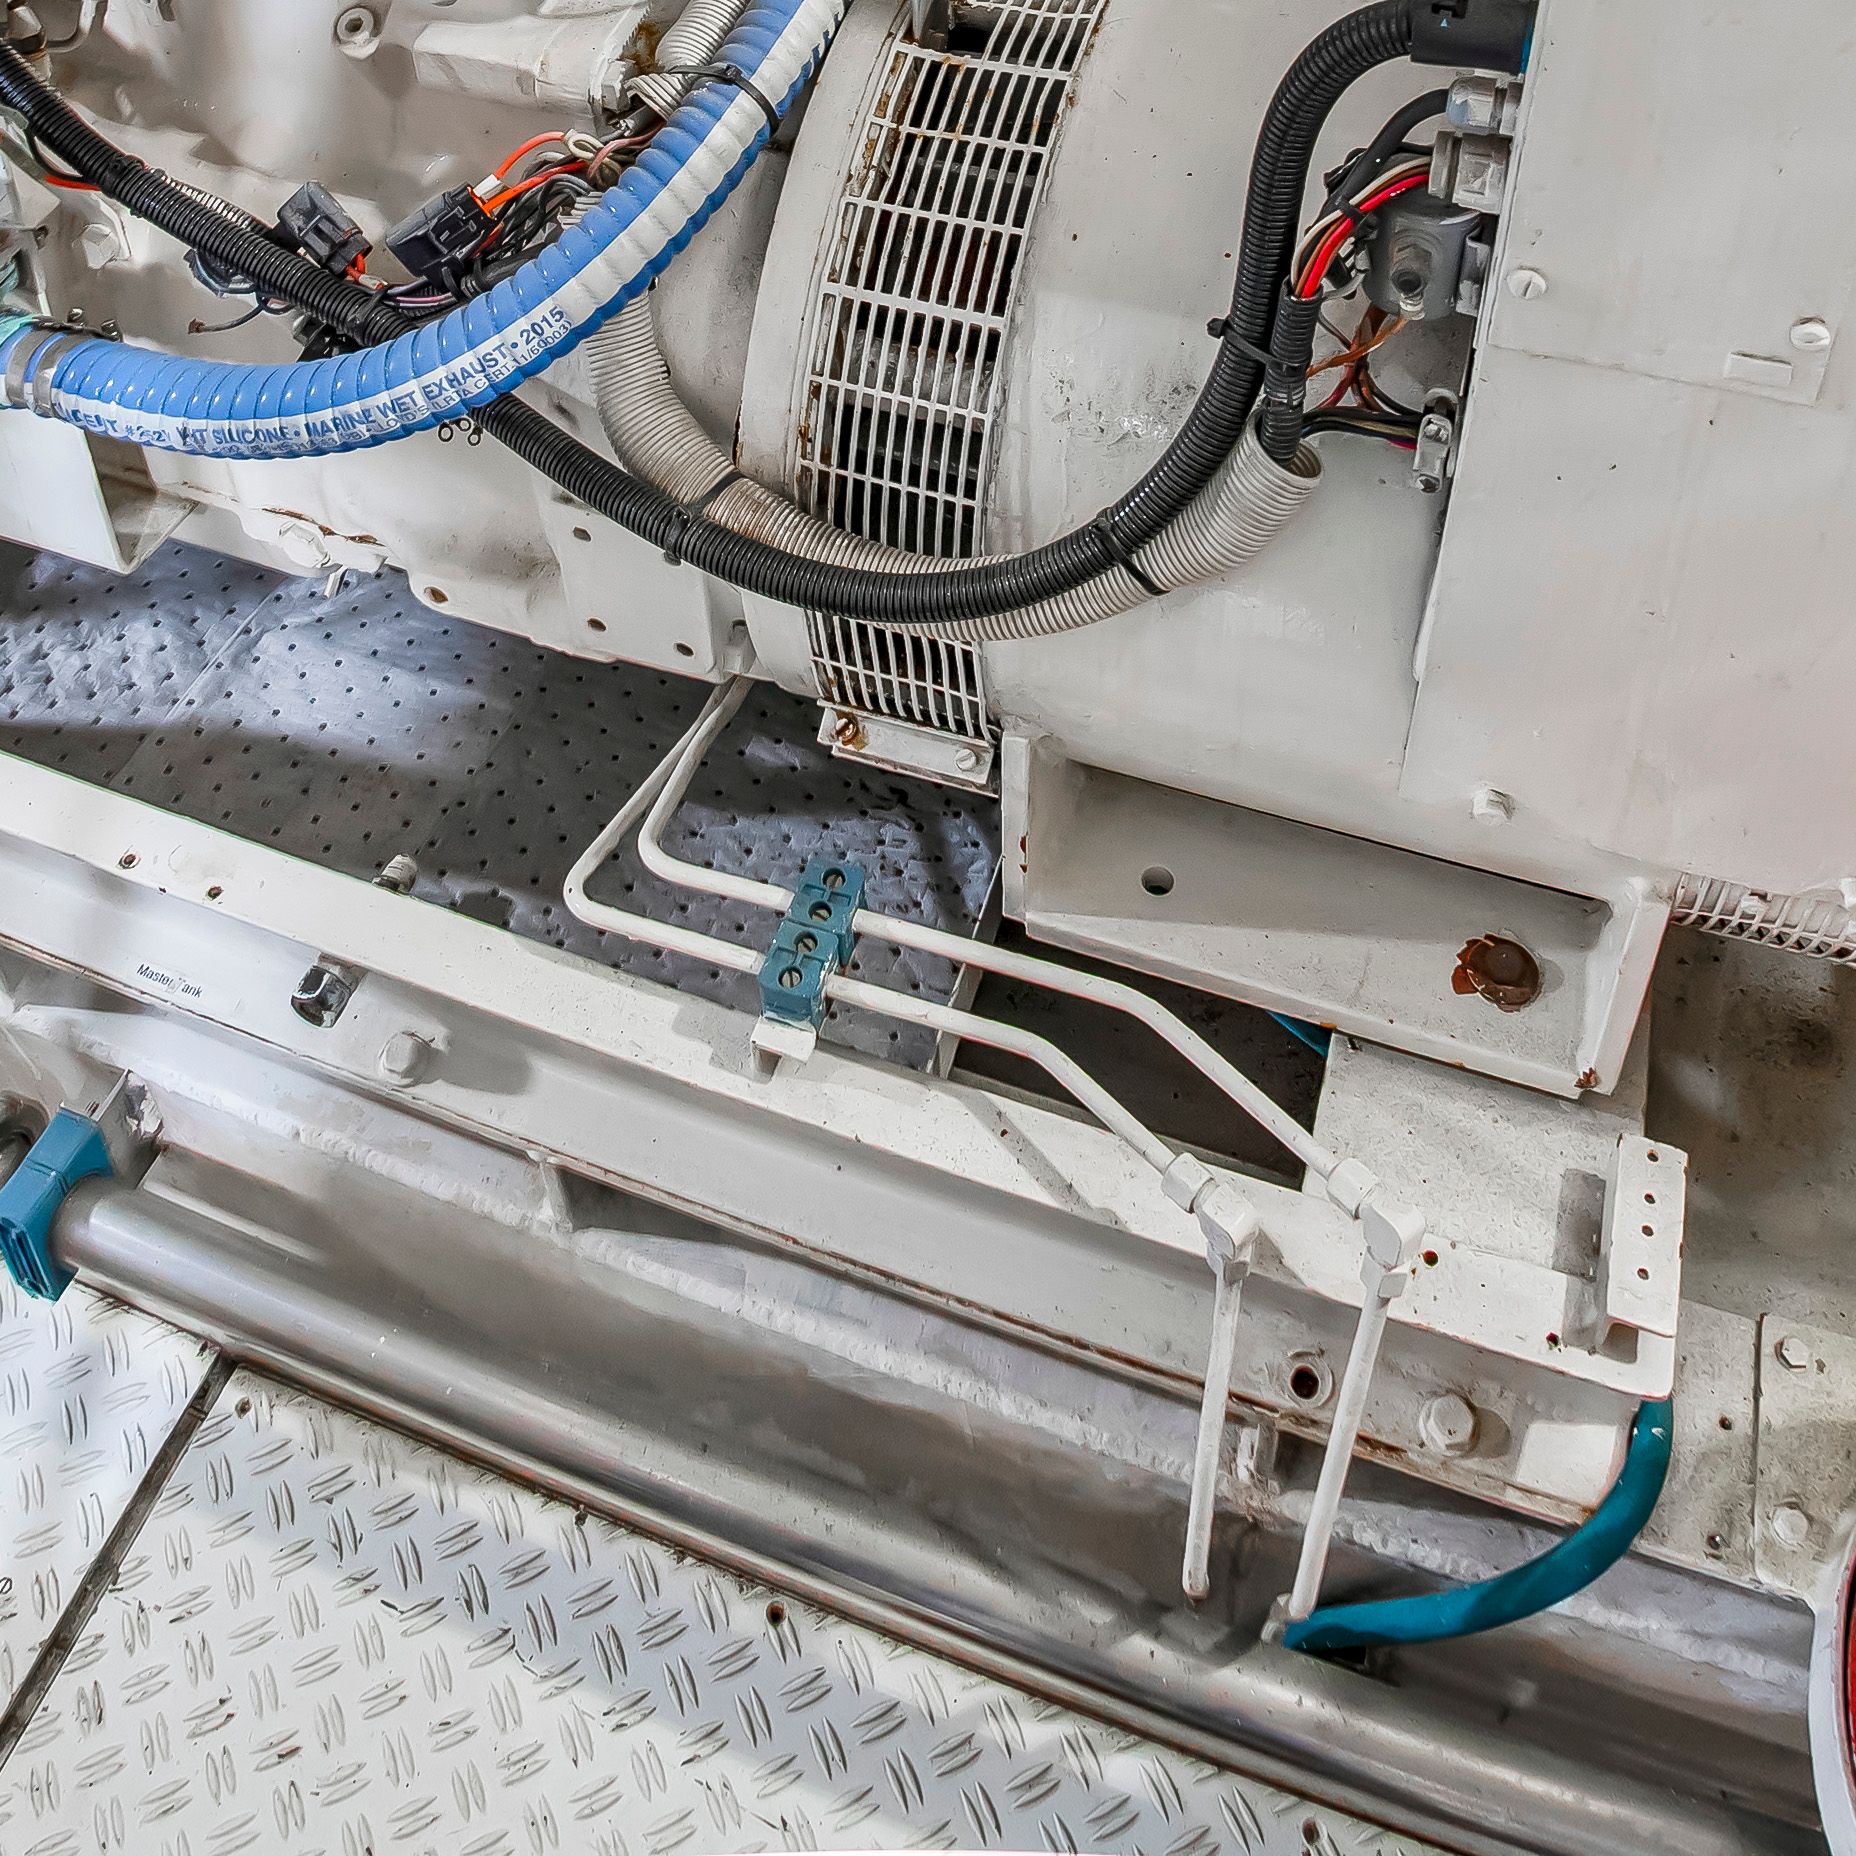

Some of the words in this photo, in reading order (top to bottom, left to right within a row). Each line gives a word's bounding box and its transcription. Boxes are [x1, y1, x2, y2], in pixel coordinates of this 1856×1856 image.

[373, 389, 419, 420] WET
[422, 342, 508, 402] EXHAUST
[519, 304, 567, 346] 2015
